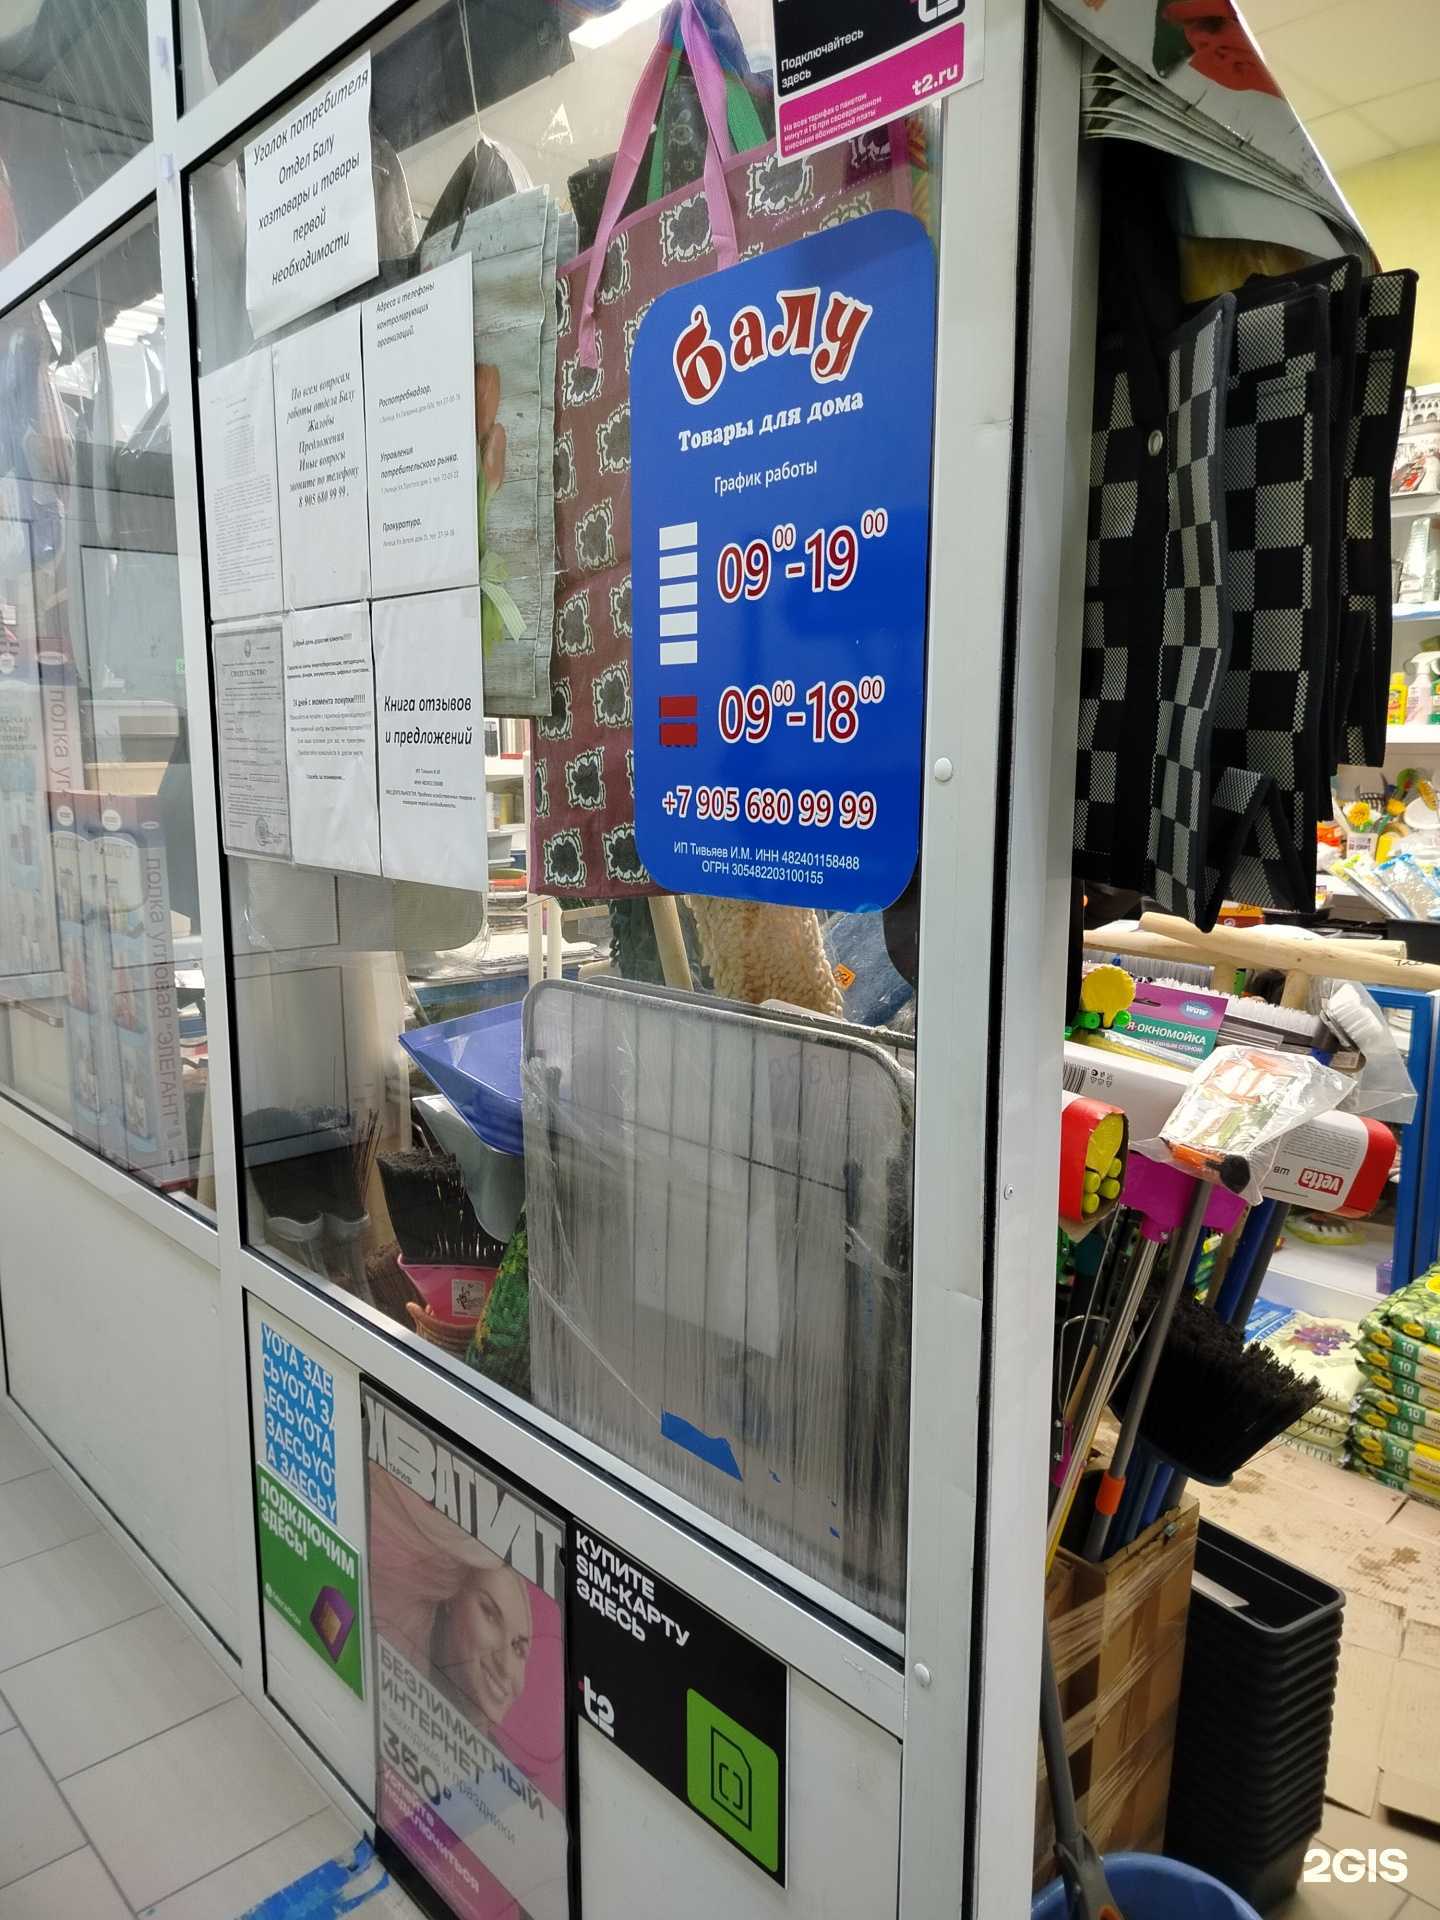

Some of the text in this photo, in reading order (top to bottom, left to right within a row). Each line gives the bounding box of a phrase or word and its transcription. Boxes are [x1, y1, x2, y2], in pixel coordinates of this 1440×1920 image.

[781, 28, 864, 72] Подключайтесь
[781, 69, 811, 88] здесь
[912, 64, 958, 96] t2.ru
[253, 69, 369, 166] Уголок потребителя
[279, 134, 335, 185] Отдел Балу
[258, 153, 361, 230] хозтовары и товары
[292, 206, 327, 244] первой
[272, 230, 350, 286] необходимости
[320, 371, 350, 392] вопросам
[307, 415, 335, 433] Жалобы
[313, 397, 337, 413] отдела
[678, 392, 863, 451] Товары для дома
[298, 433, 345, 456] Предложения
[299, 451, 346, 472] Иные вопросы
[381, 458, 436, 479] потребительского
[714, 459, 817, 496] График работы
[304, 492, 316, 507] 905
[48, 688, 69, 758] полка
[384, 695, 472, 713] Книга отзывов
[385, 731, 392, 744] и
[394, 726, 473, 747] предложений
[662, 785, 877, 829] +7 905 680 99 99
[673, 842, 860, 871] ИП Тивьяев И.М. ИНН 482401158488
[702, 860, 824, 885] ОГРН 305482203100155
[147, 857, 164, 923] полка
[263, 1325, 299, 1371] YOTA
[260, 1477, 355, 1579] ПОДКЛЮЧИМ
[261, 1502, 308, 1562] ЗДЕСЬ!
[576, 1530, 655, 1602] КУПИТЕ
[576, 1554, 690, 1648] SIM-КАРТУ
[576, 1577, 646, 1642] ЗДЕСЬ
[579, 1674, 615, 1739] t2
[381, 1678, 483, 1785] ИНТЕРНЕТ
[381, 1647, 544, 1822] БЕЗЛИМИТНЫЙ
